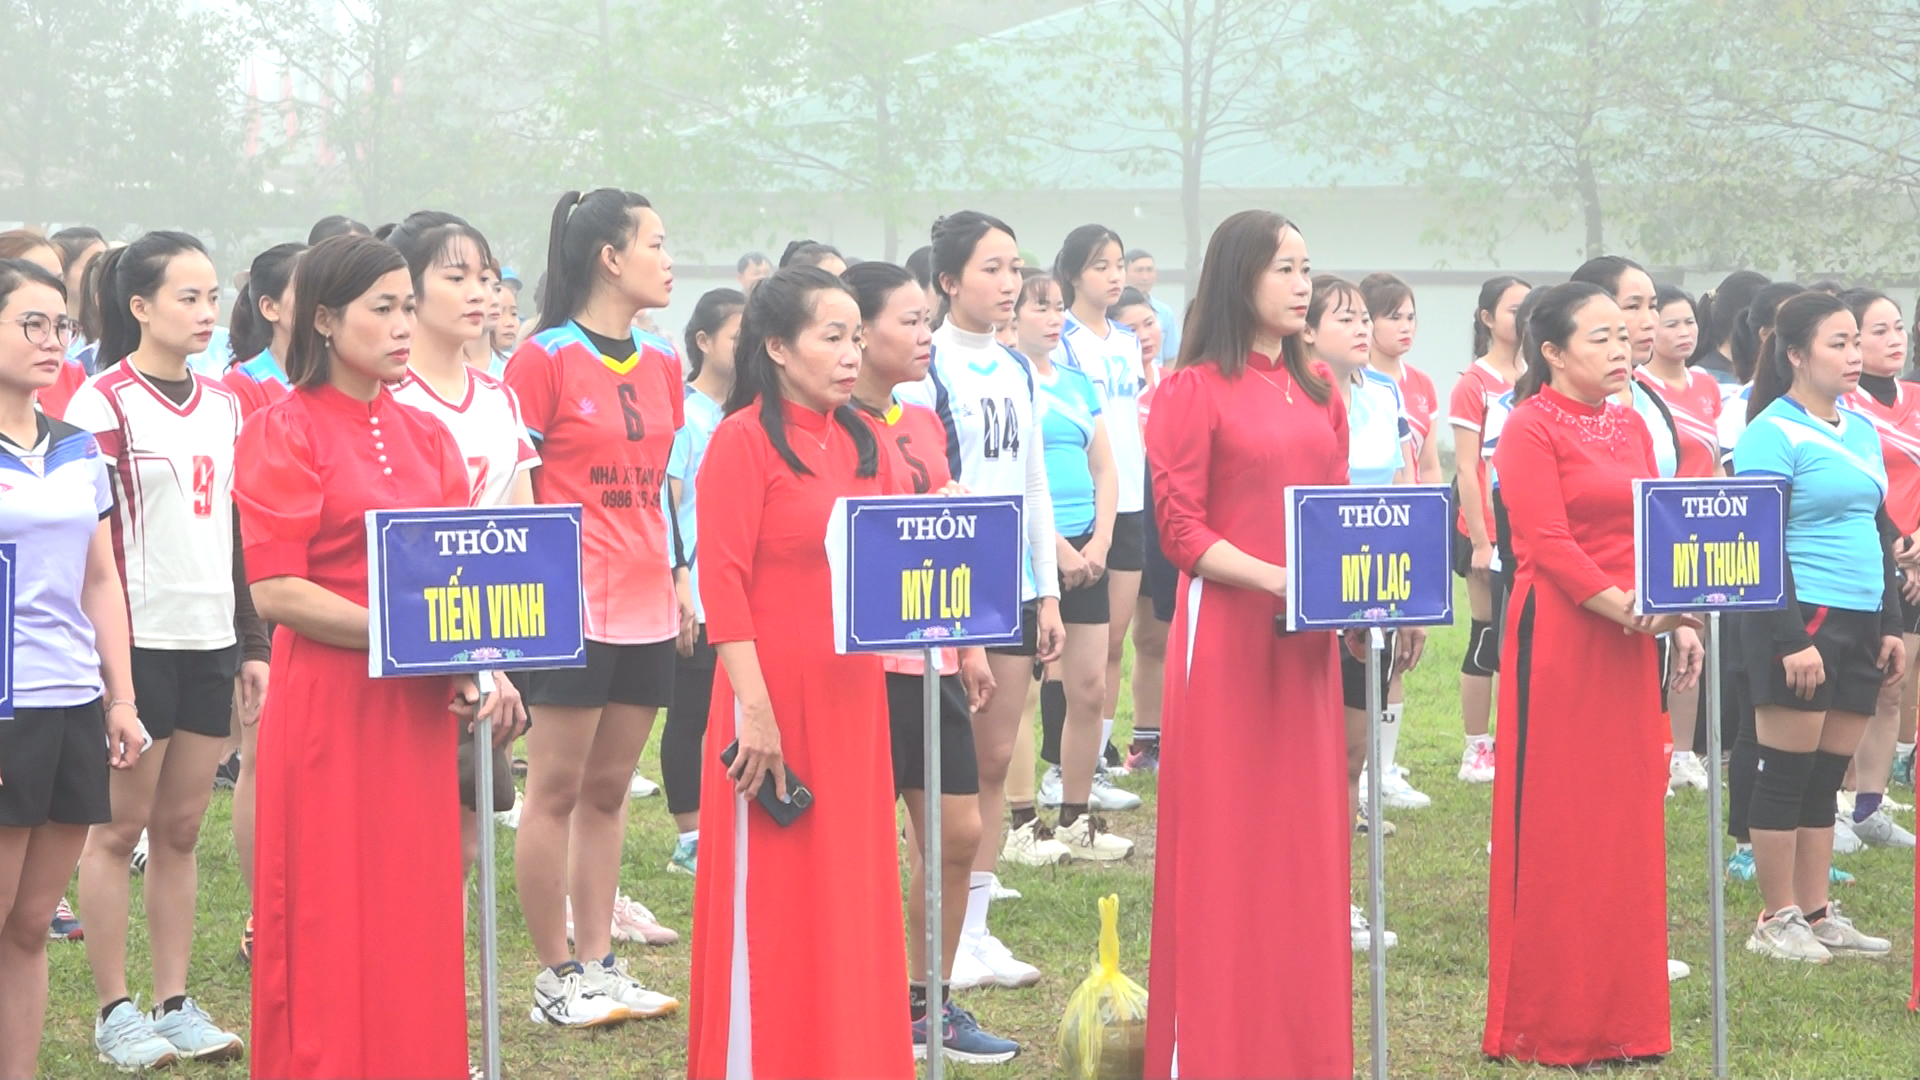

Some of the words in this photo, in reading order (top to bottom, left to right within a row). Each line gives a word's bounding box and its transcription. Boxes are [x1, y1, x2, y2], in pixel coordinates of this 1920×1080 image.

[1100, 355, 1134, 398] 12
[617, 382, 645, 442] 6
[980, 397, 1020, 461] 04
[193, 455, 215, 519] 9
[467, 456, 490, 508] 7
[896, 433, 931, 495] 5
[601, 490, 632, 508] 0986
[897, 508, 977, 540] THÔN
[1339, 497, 1410, 527] THÔN
[1682, 488, 1748, 518] THÔN
[435, 520, 529, 556] THÔN
[1673, 533, 1699, 588] MỸ
[1703, 531, 1760, 596] THUẬN
[424, 566, 481, 642] TIẾN
[486, 583, 546, 639] VINH
[902, 558, 934, 620] MỸ
[940, 563, 971, 630] LỢI
[1342, 544, 1371, 602] MỸ
[1377, 552, 1411, 612] LẠC
